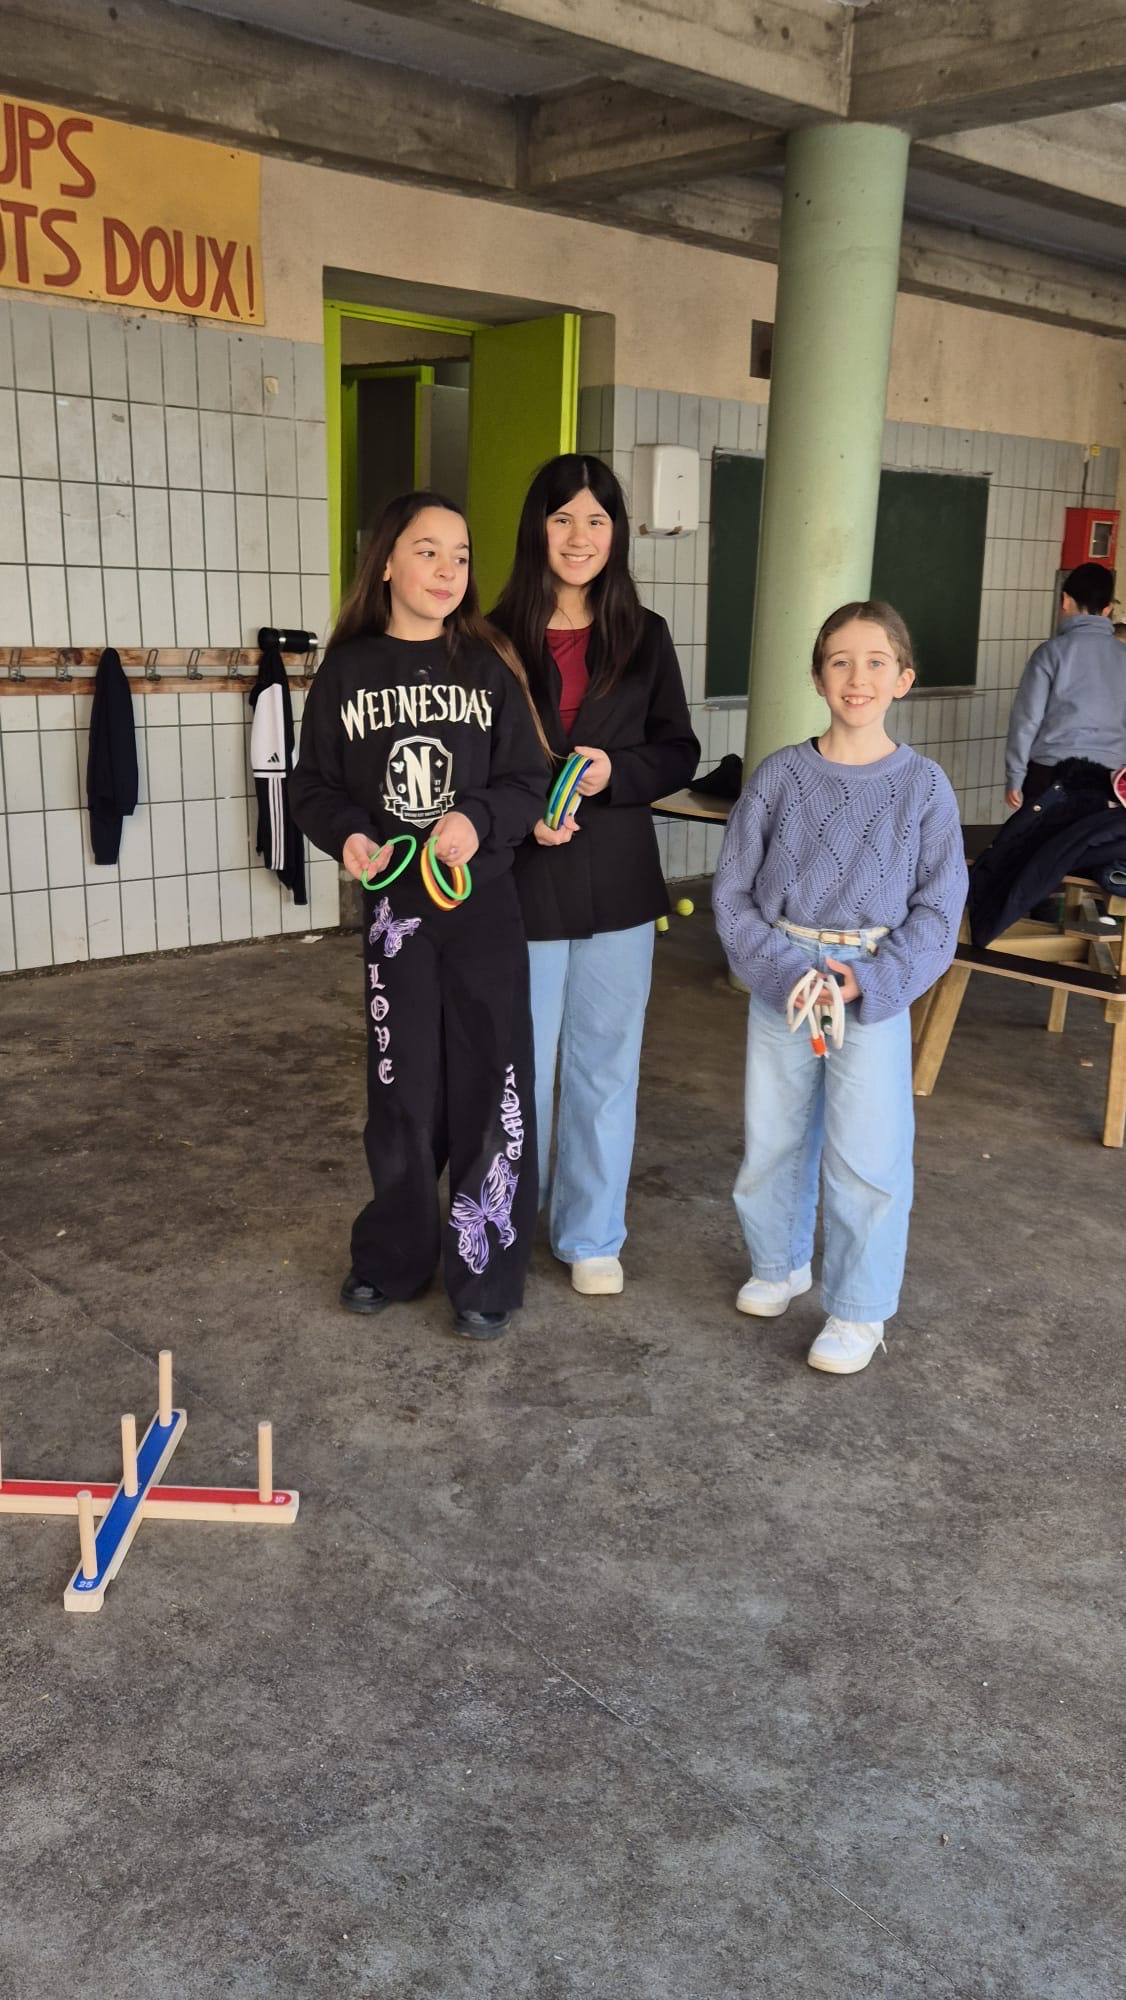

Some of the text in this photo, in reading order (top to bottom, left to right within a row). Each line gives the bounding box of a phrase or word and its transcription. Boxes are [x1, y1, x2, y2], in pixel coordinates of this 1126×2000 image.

[0, 199, 255, 317] TS DOUX!
[340, 684, 493, 742] WEDNESDAY
[403, 746, 432, 808] N
[77, 1580, 94, 1588] 25
